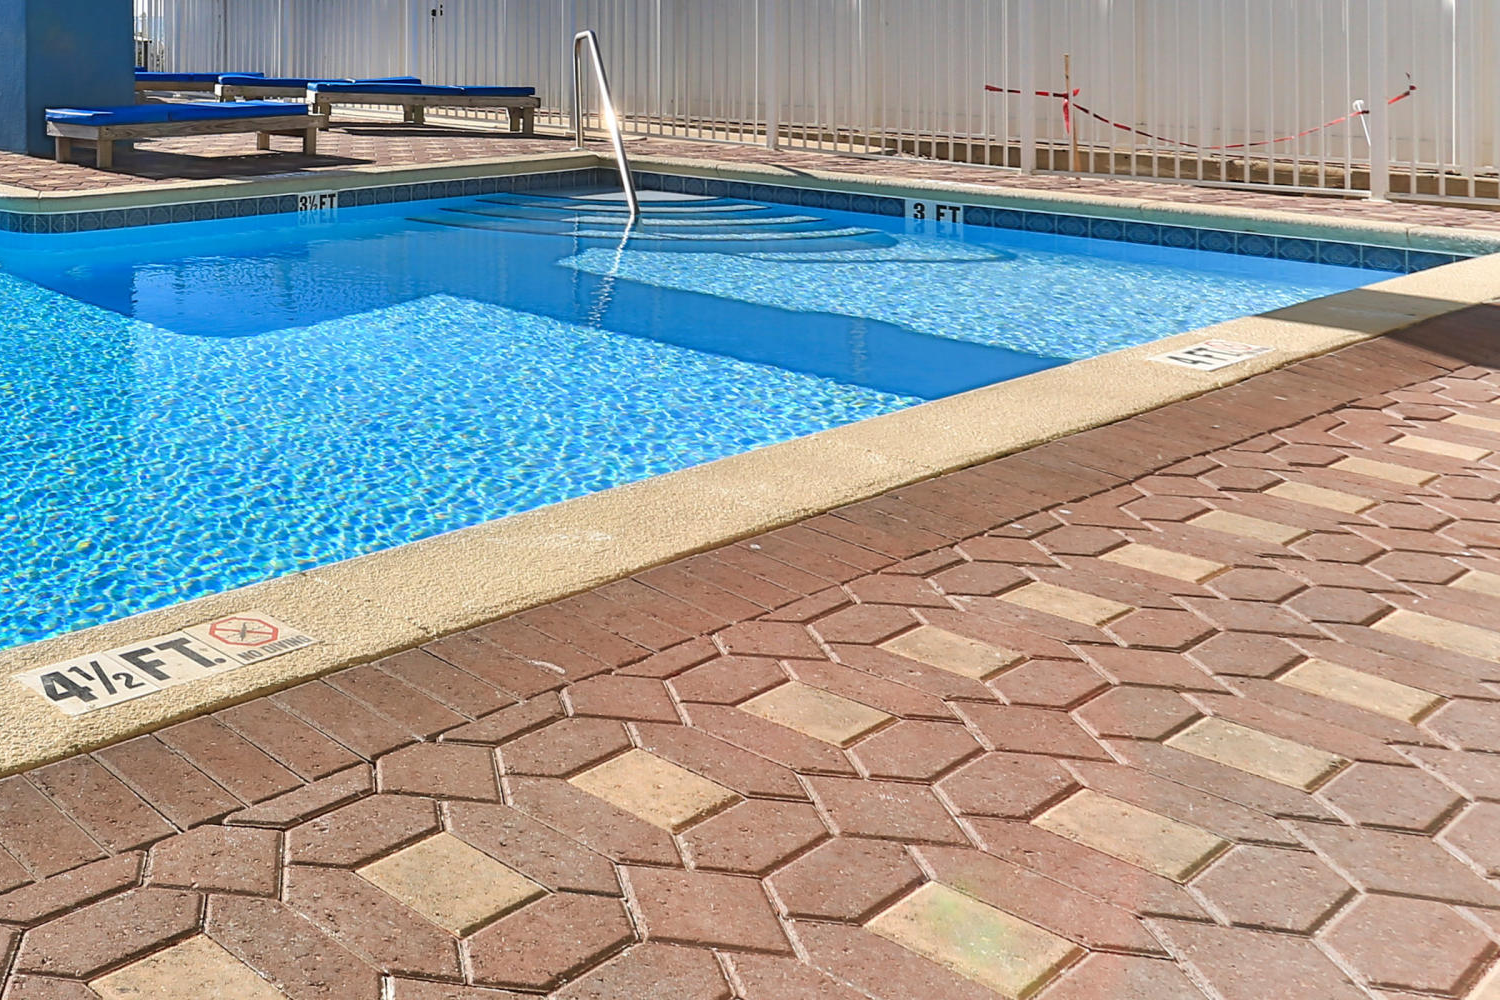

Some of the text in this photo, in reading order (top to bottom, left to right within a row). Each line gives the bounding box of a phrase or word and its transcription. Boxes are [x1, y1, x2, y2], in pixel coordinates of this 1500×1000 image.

[320, 193, 336, 209] FT
[913, 203, 960, 223] 3 FT
[120, 637, 227, 681] FT.
[237, 635, 312, 662] NO DIVING
